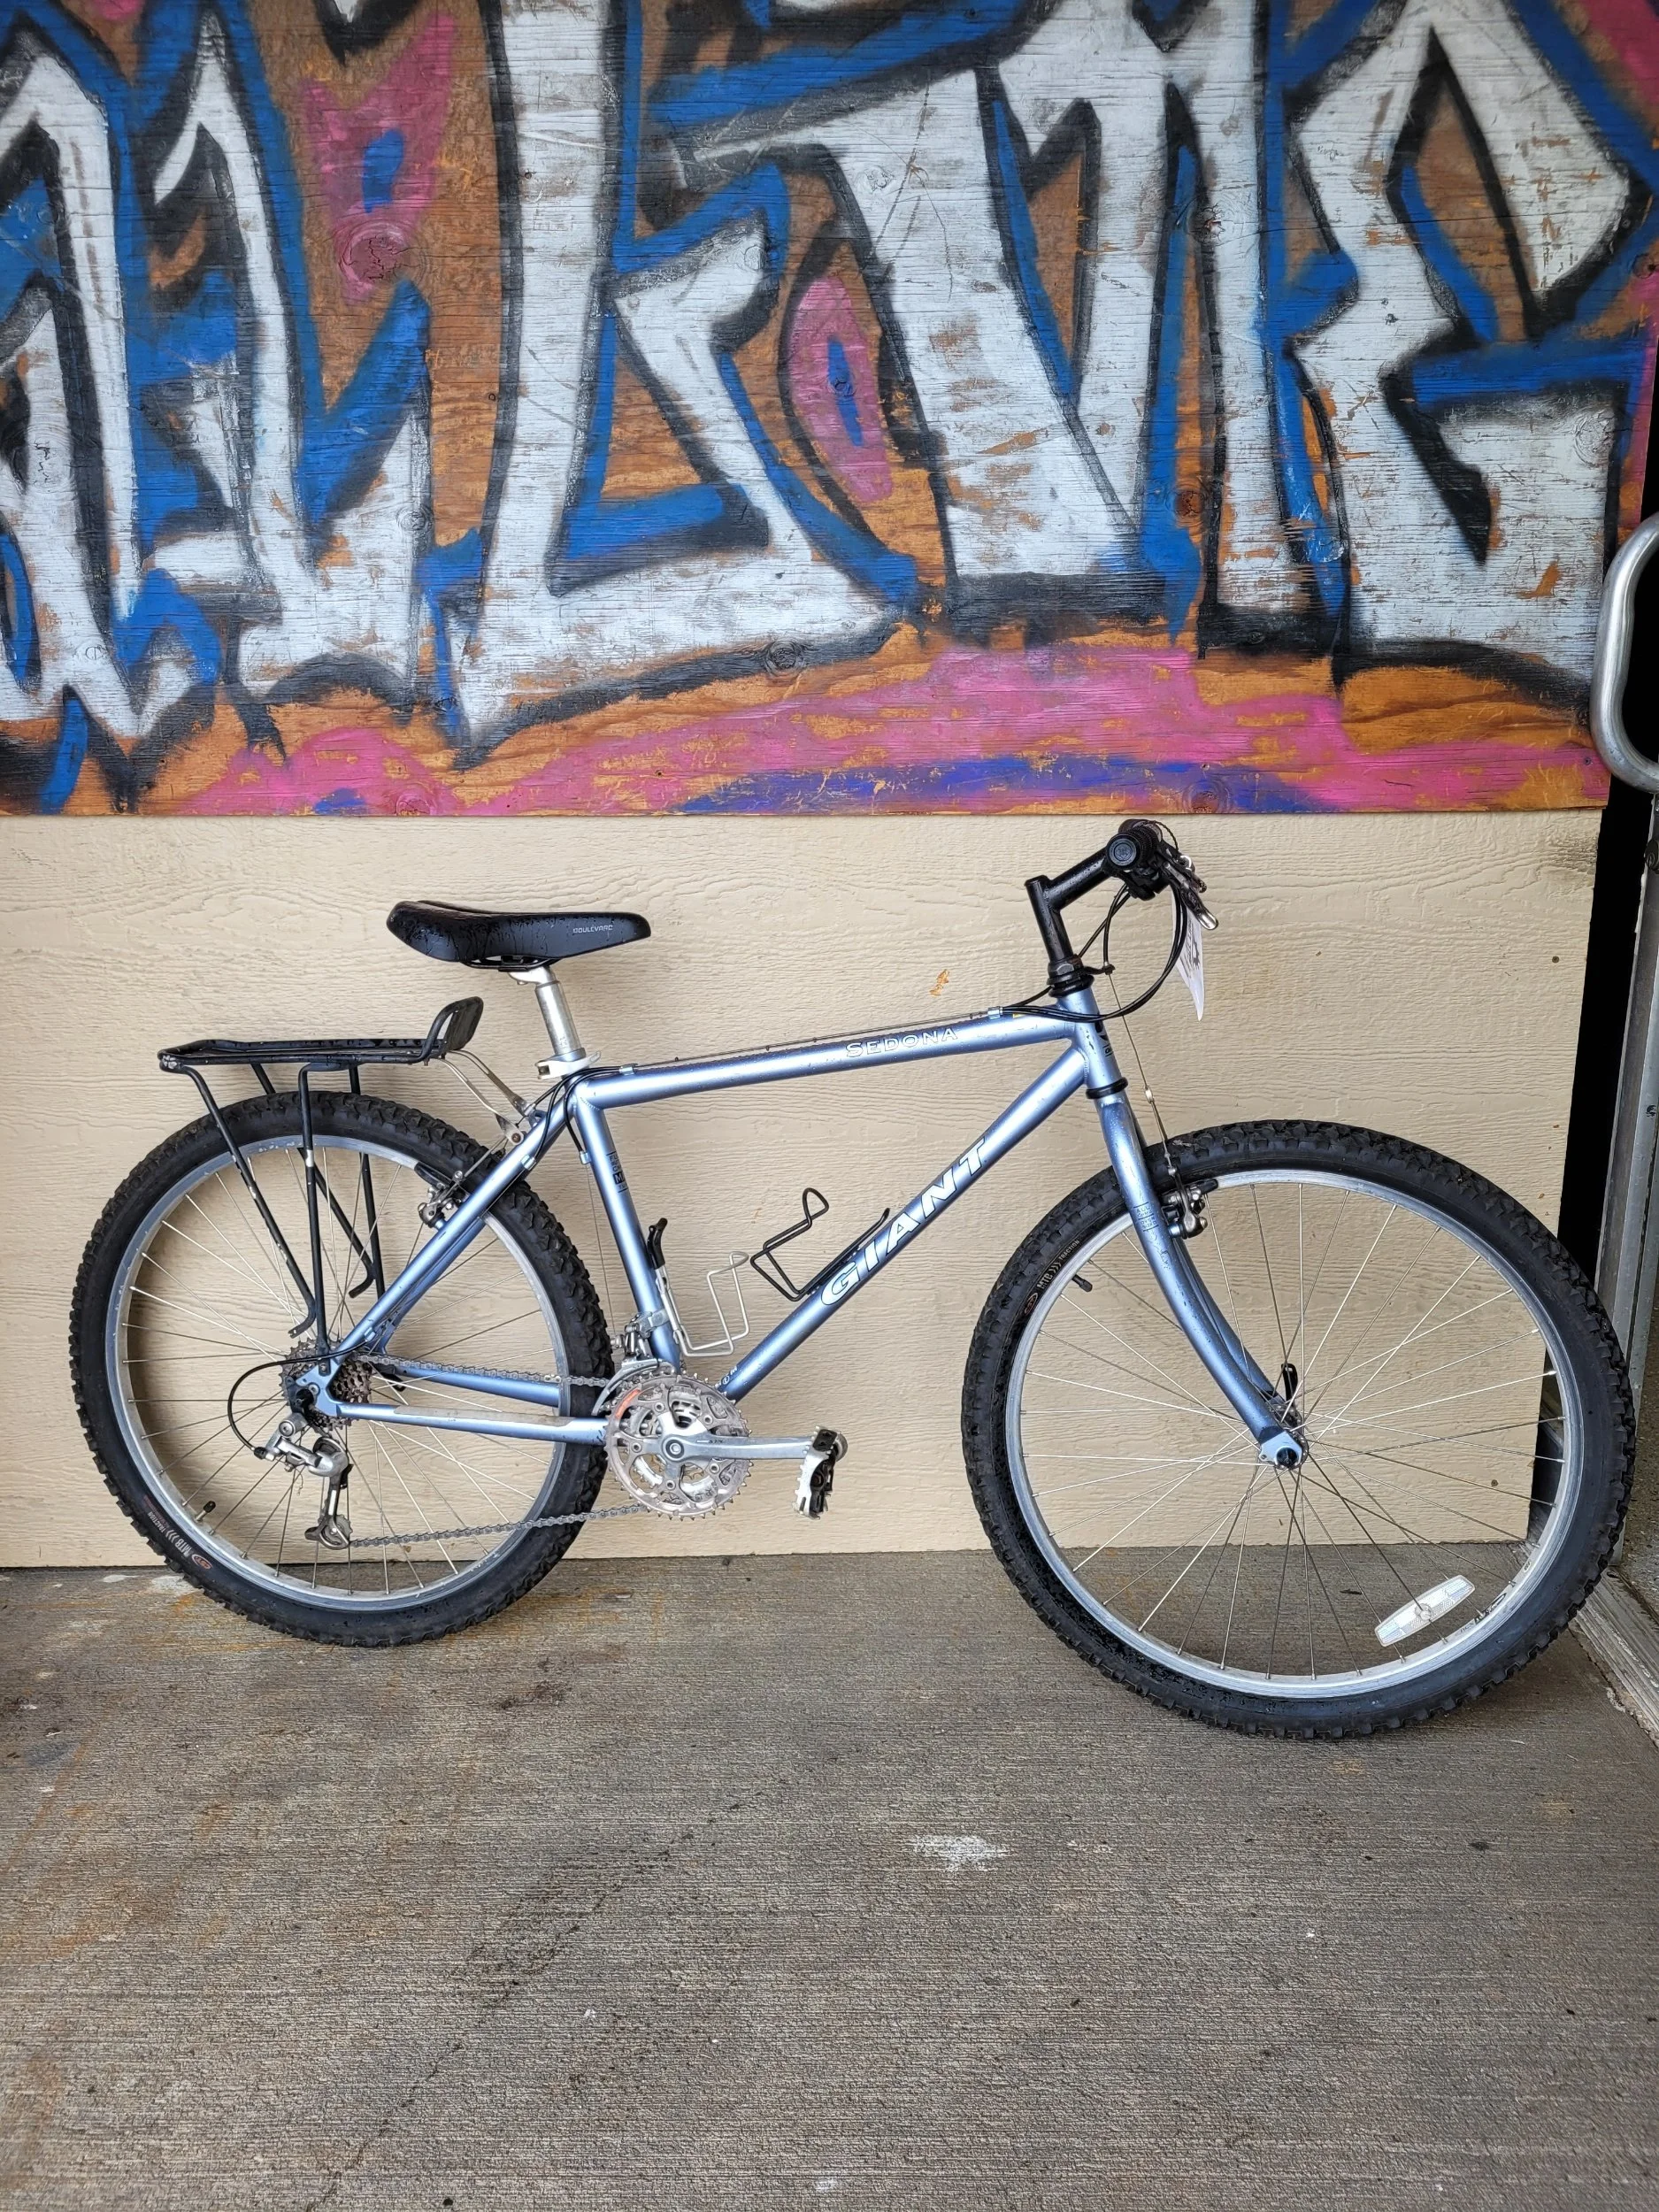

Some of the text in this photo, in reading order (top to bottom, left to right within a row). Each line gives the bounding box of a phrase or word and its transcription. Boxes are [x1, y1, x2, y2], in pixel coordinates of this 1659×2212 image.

[846, 1027, 958, 1058] SEDONA
[821, 1137, 986, 1306] GIANT
[1059, 1240, 1079, 1261] TRACTION
[148, 1511, 166, 1533] TRACTION
[174, 1538, 192, 1557] MTB
